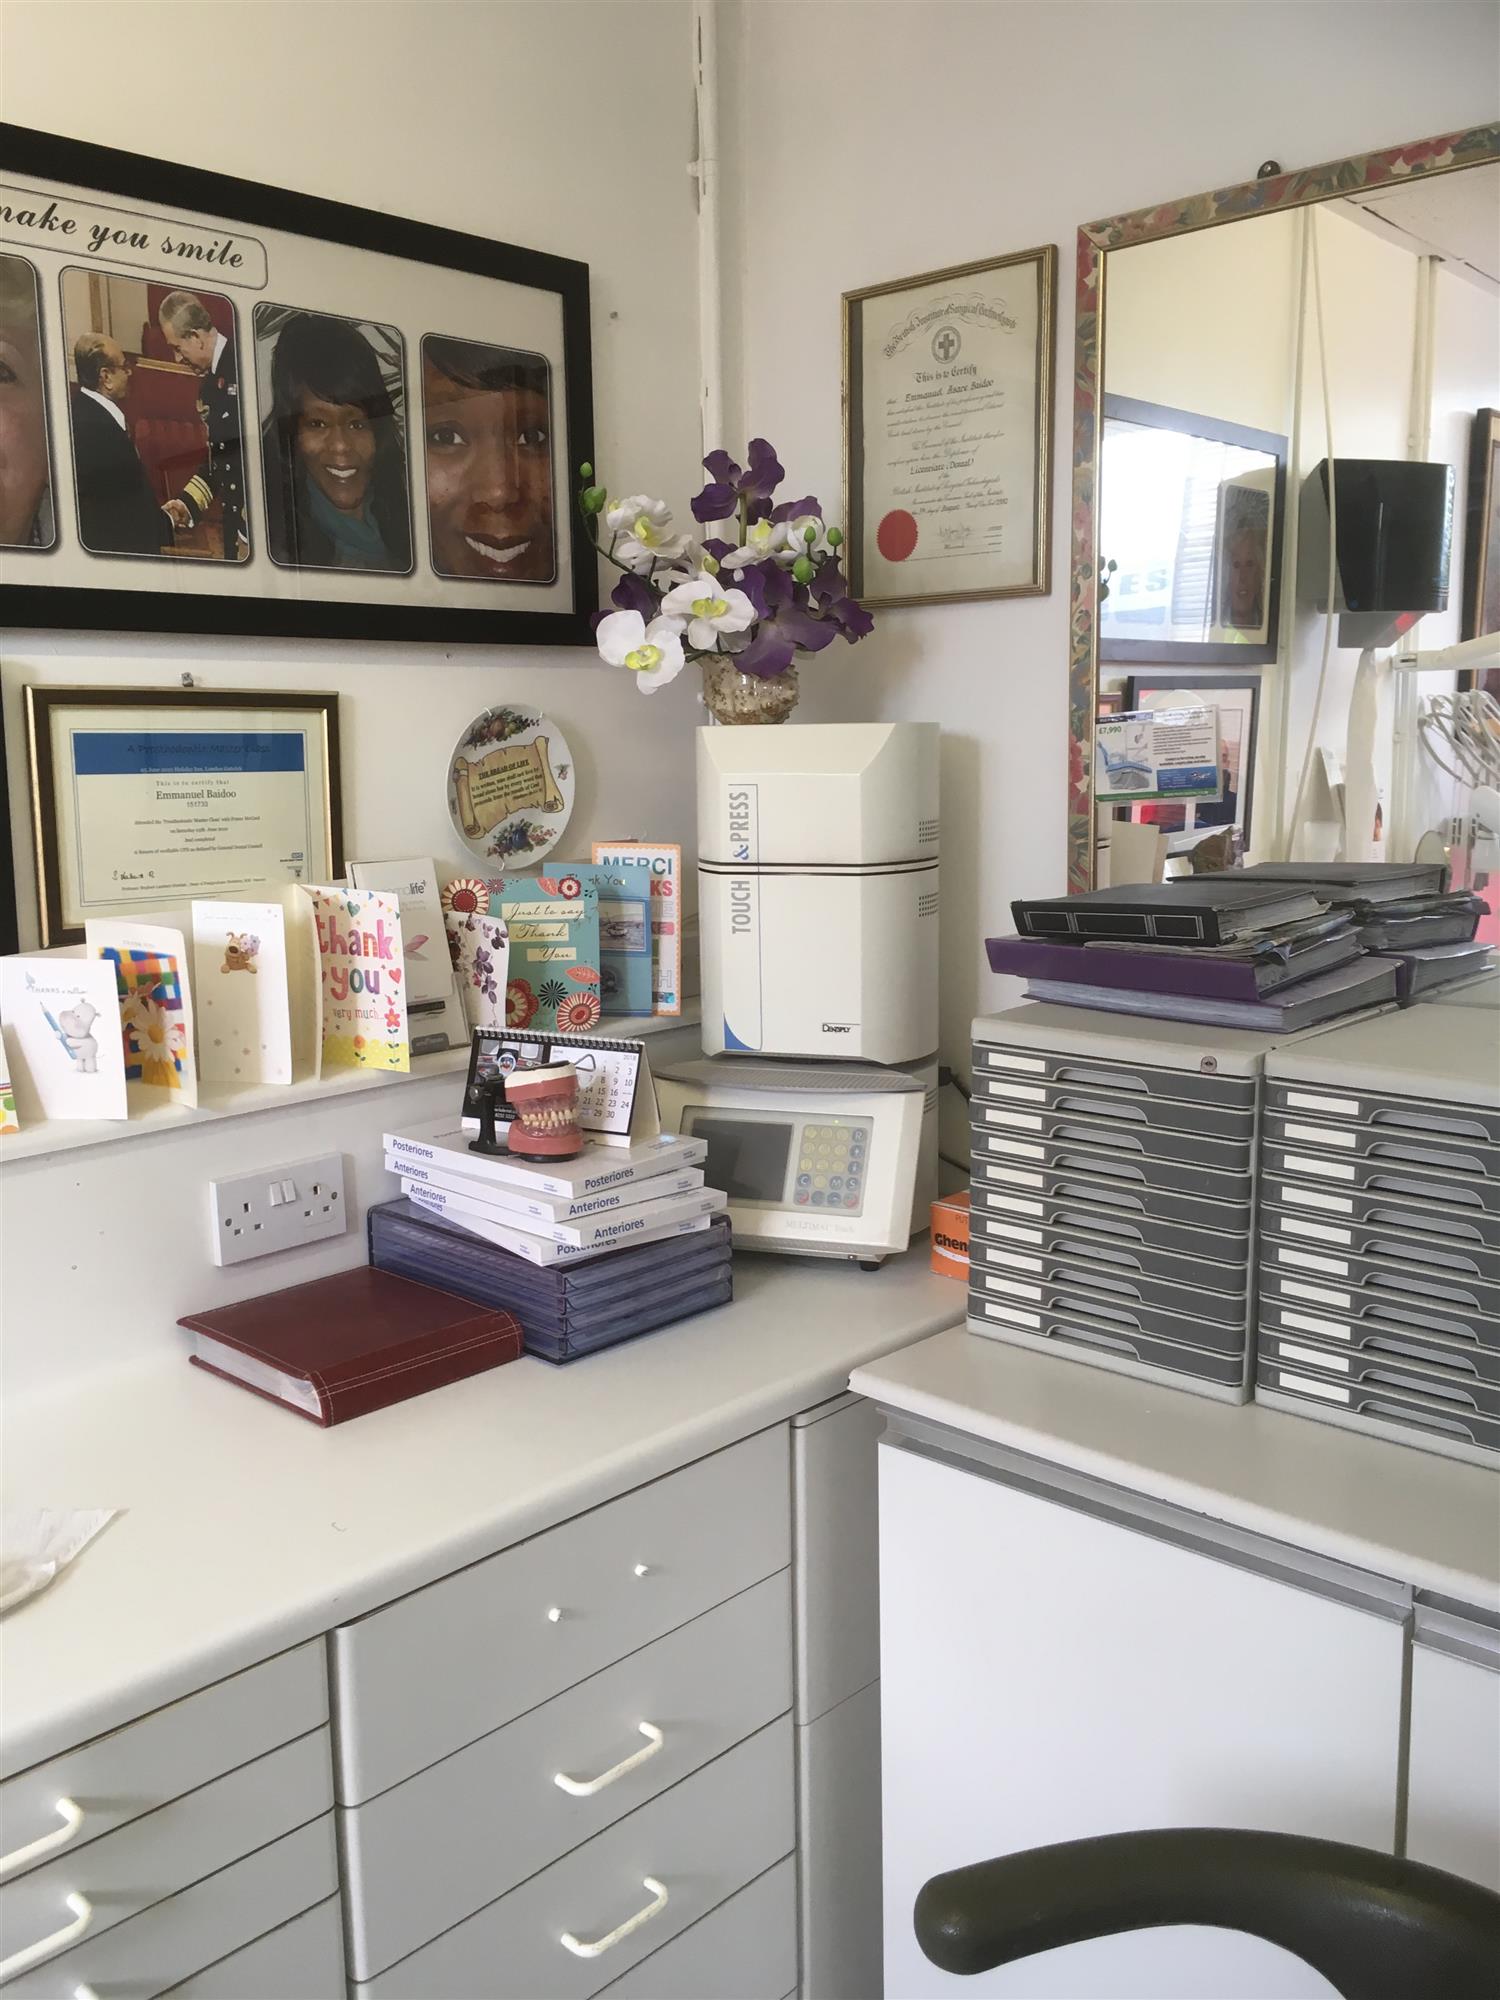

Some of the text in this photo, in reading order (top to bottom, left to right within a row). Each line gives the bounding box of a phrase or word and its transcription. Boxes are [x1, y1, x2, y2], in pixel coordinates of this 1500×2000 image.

[88, 225, 149, 252] you
[161, 236, 244, 268] smile
[914, 371, 934, 383] This
[935, 370, 942, 380] is
[951, 364, 977, 378] Certify
[1098, 726, 1122, 735] £7,990
[156, 788, 237, 800] Emmanuel Baidoo
[729, 791, 751, 935] TOUCH & PRESS
[506, 903, 540, 922] Just
[543, 904, 558, 916] to
[315, 914, 394, 961] thank
[515, 923, 567, 939] Thank
[538, 944, 572, 964] You
[330, 966, 381, 1001] you
[627, 1068, 633, 1076] 3
[585, 1086, 593, 1094] 14
[598, 1087, 606, 1095] 15
[610, 1089, 619, 1097] 16
[612, 1078, 618, 1086] 9
[624, 1079, 633, 1087] 10
[582, 1096, 630, 1109] 21 22 23 24
[593, 1109, 602, 1117] 29
[606, 1111, 615, 1119] 30
[392, 1139, 434, 1159] Posteriores
[394, 1161, 429, 1180] Anteriores
[584, 1166, 634, 1190] Posteriores
[410, 1184, 447, 1204] Anteriores
[569, 1194, 620, 1216] Anteriores
[594, 1217, 645, 1240] Anteriores
